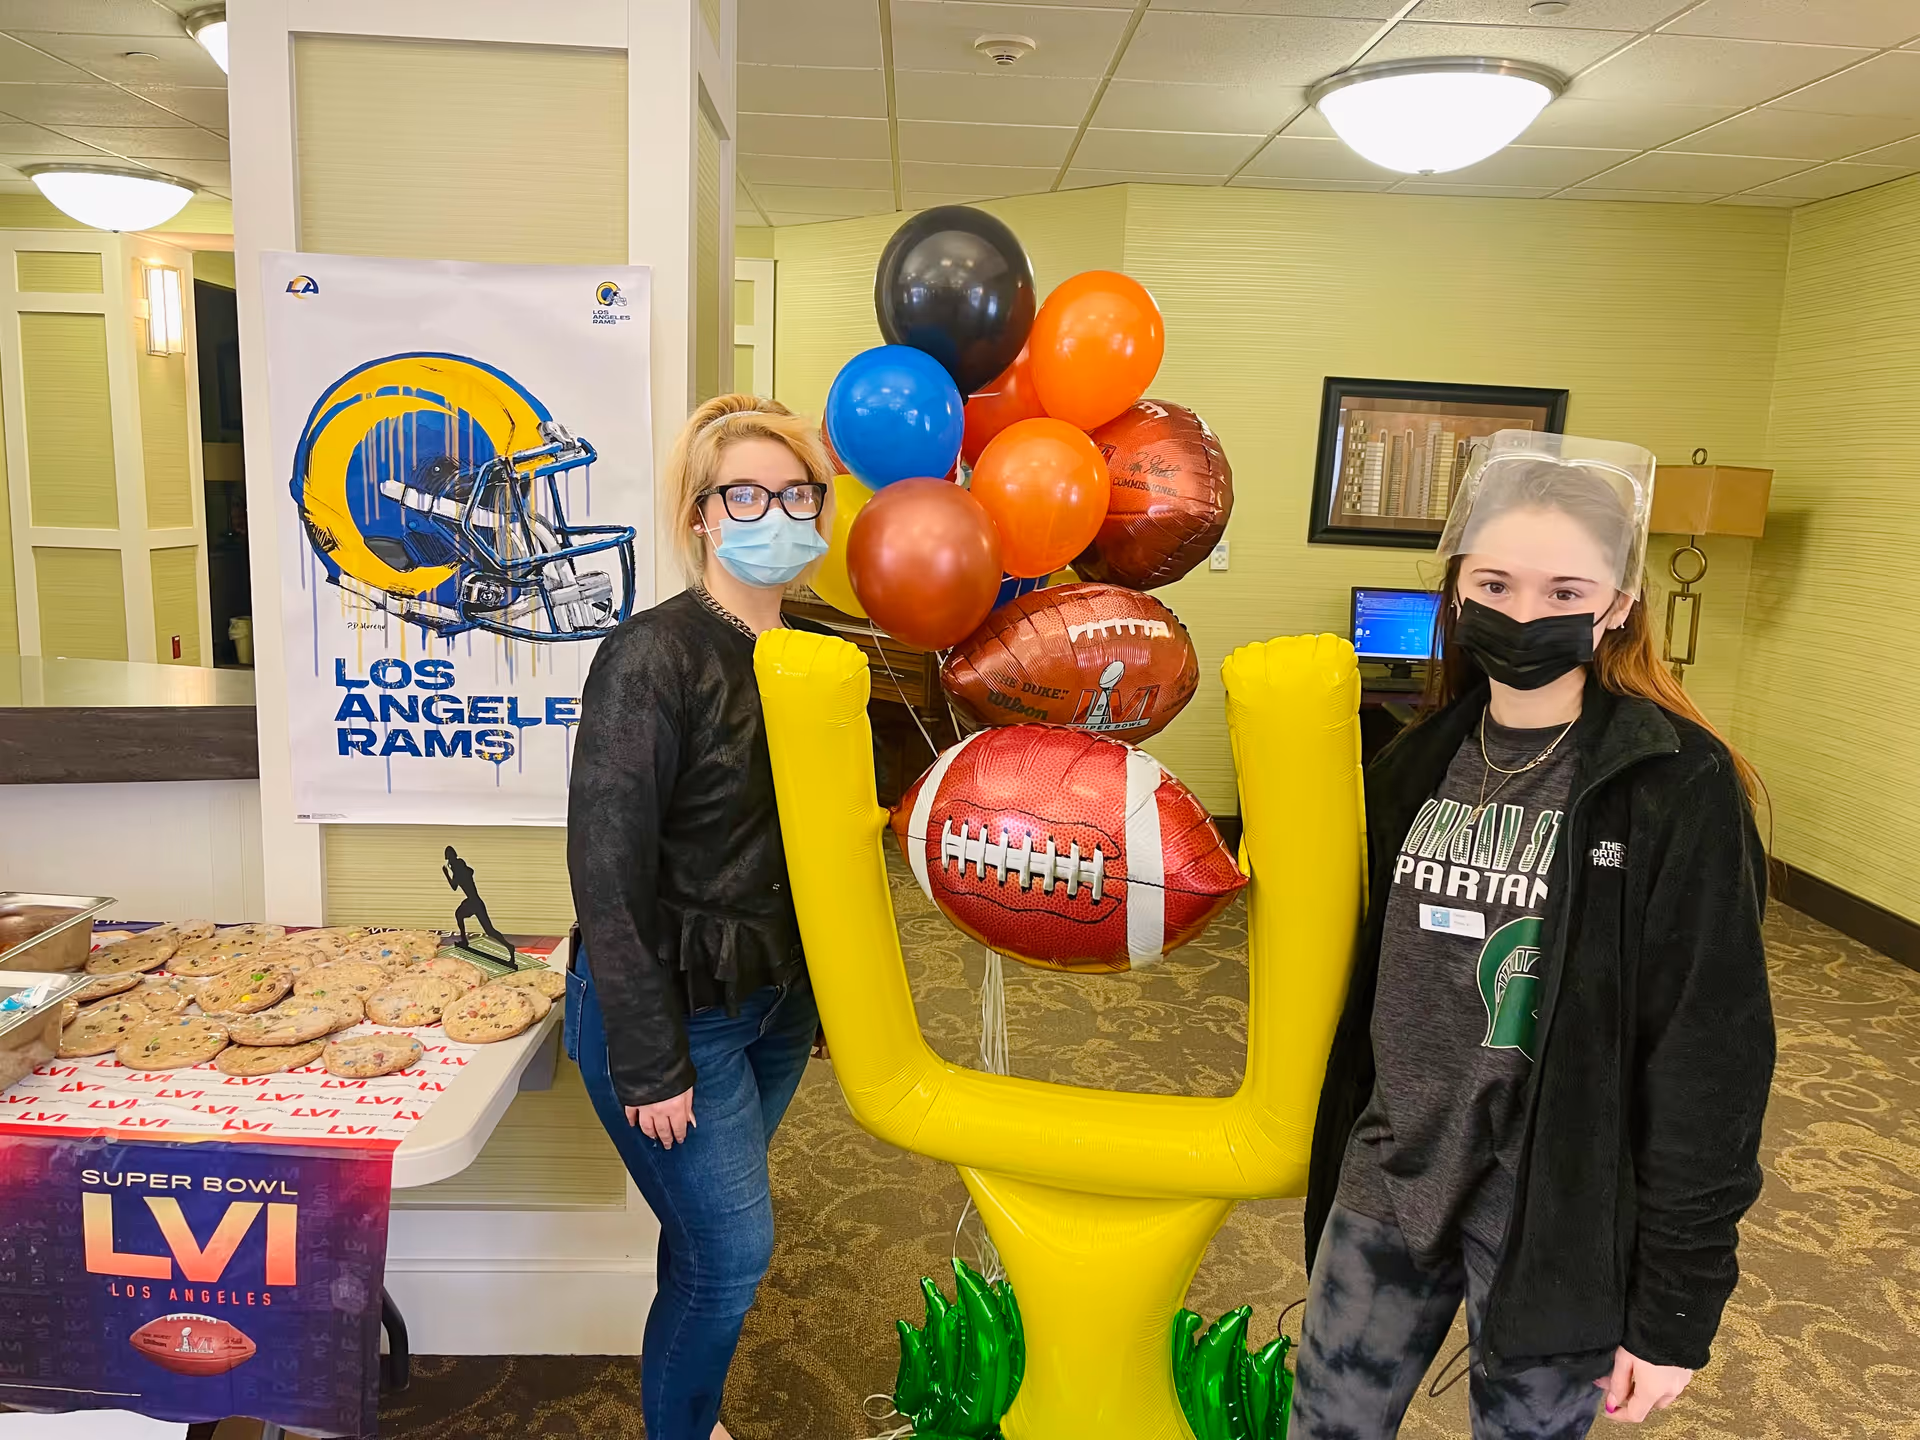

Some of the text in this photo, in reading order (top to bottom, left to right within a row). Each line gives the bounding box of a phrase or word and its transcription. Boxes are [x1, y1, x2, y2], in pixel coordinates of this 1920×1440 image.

[285, 275, 319, 295] LA
[1112, 477, 1178, 497] COMMISSIONER
[335, 657, 456, 690] LOS
[334, 693, 582, 728] ANGELE
[1114, 720, 1142, 730] BOWL
[336, 727, 516, 762] RAMS
[1400, 798, 1524, 872] ICHIGAN
[1600, 841, 1622, 851] THE
[1592, 849, 1622, 860] ORTH
[1593, 857, 1621, 868] FACE
[1393, 854, 1549, 909] PARTAN
[440, 1057, 469, 1066] LV
[33, 1066, 79, 1077] LVI
[125, 1073, 174, 1083] LVI
[222, 1077, 271, 1086] LVI
[57, 1081, 106, 1092] LVI
[320, 1080, 368, 1088] LVI
[418, 1081, 447, 1091] LV
[155, 1089, 205, 1099] LVI
[255, 1092, 305, 1102] LVI
[88, 1099, 139, 1109] LVI
[355, 1096, 404, 1105] LVI
[191, 1104, 240, 1115] LVI
[290, 1108, 341, 1118] LVI
[16, 1112, 69, 1122] LVI
[392, 1111, 425, 1120] LV
[118, 1117, 171, 1128] LVI
[222, 1118, 273, 1132] LVI
[326, 1125, 379, 1135] LVI
[81, 1169, 298, 1196] SUPER BOWL
[82, 1191, 298, 1286] LVI
[111, 1282, 272, 1306] LOS ANGELES
